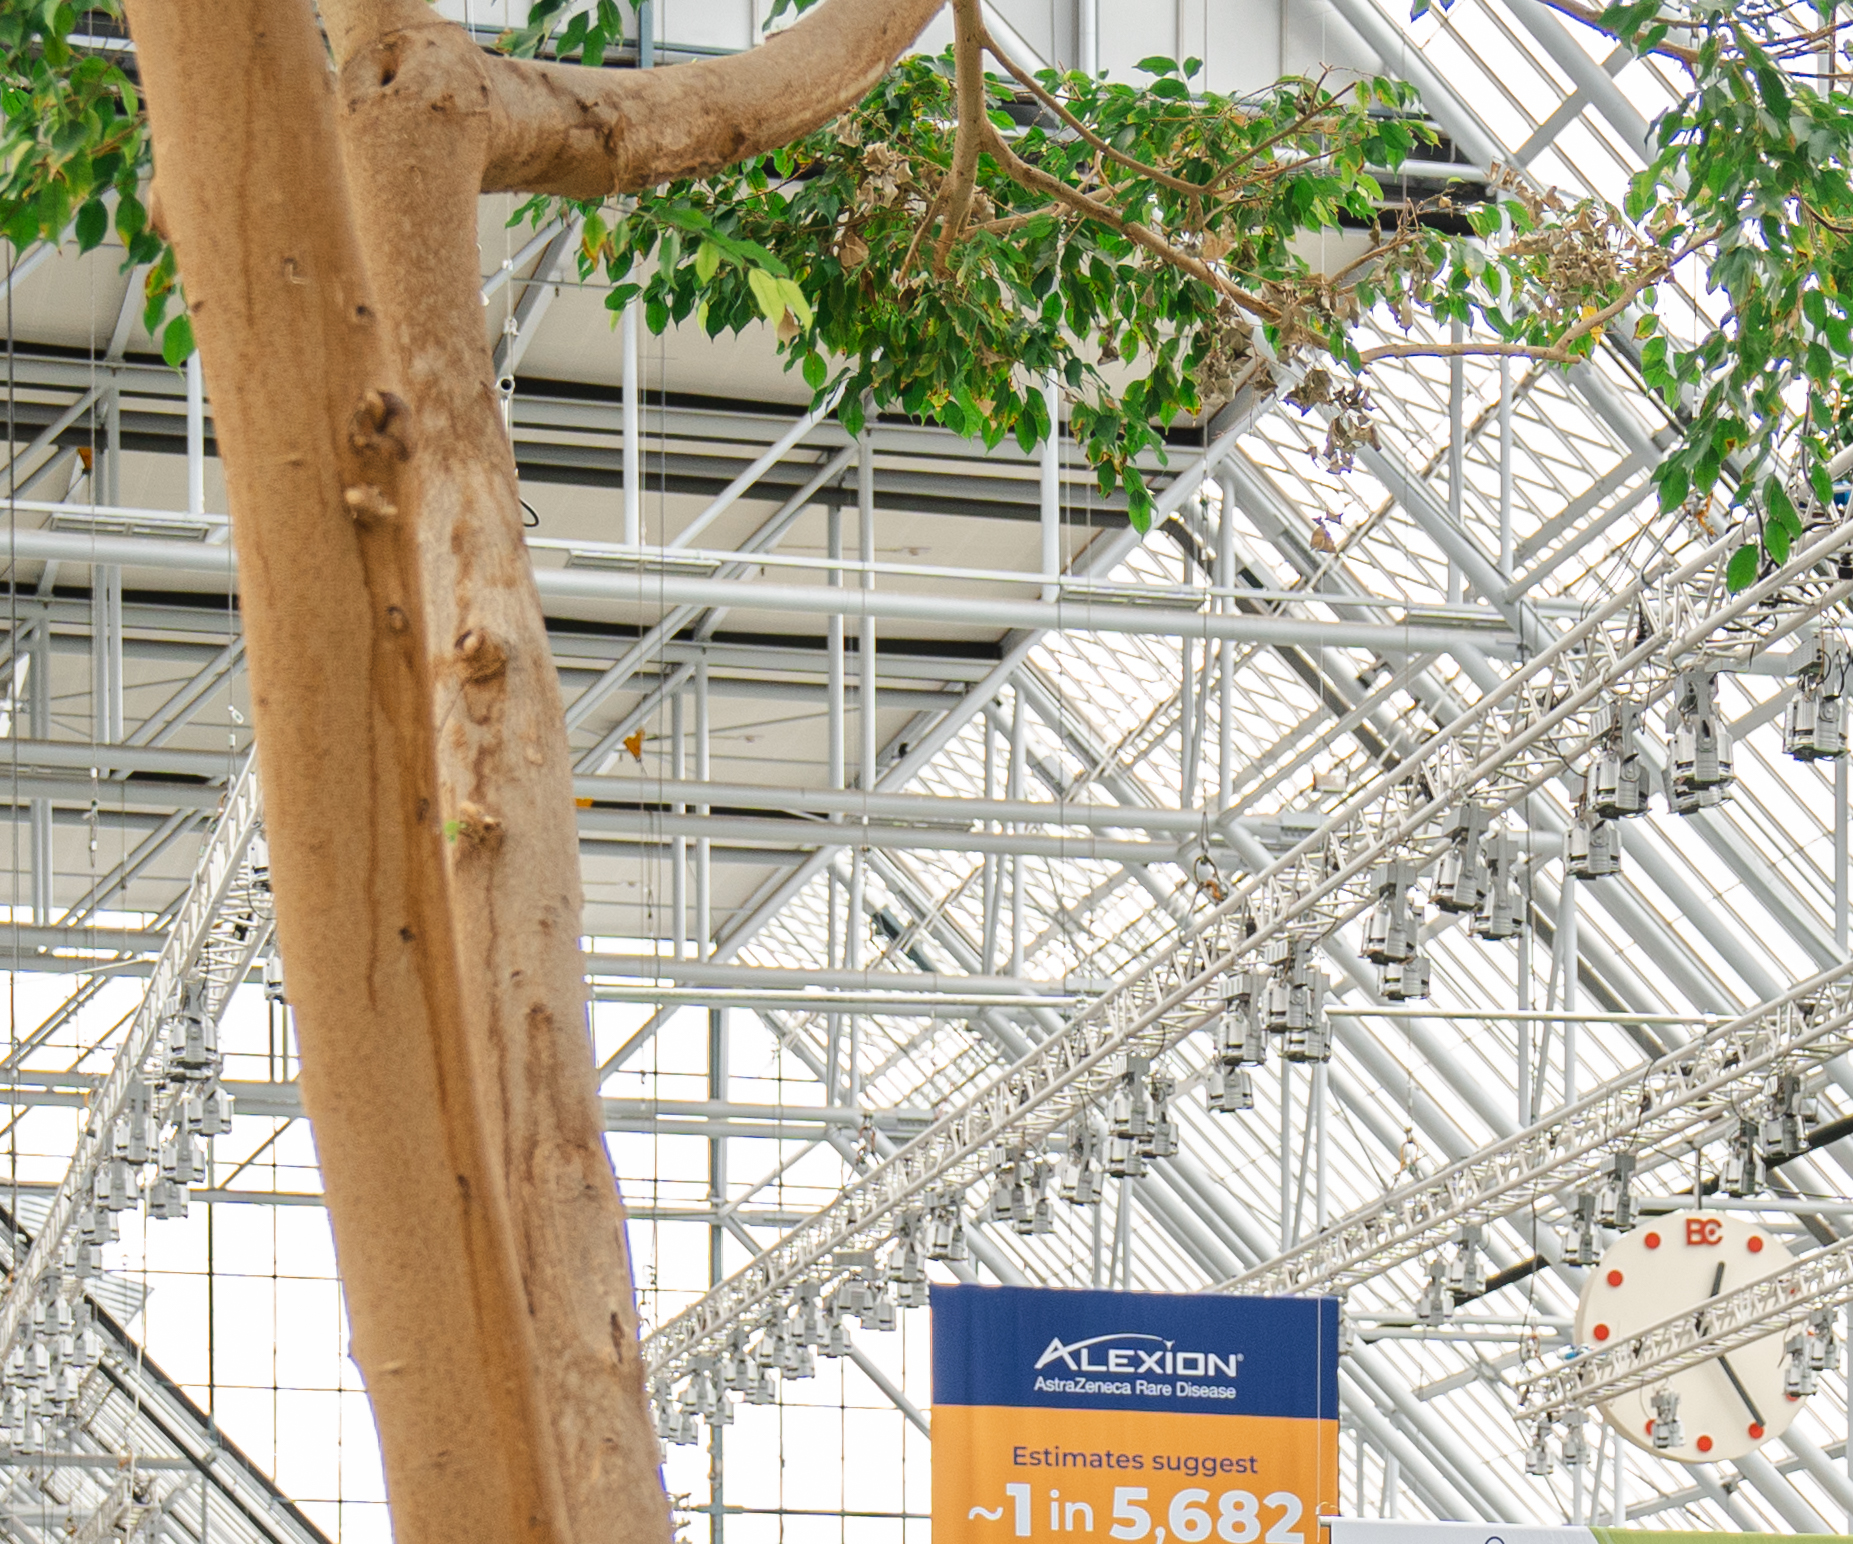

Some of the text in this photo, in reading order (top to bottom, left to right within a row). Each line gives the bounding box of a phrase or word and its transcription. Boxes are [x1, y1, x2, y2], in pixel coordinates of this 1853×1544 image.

[1034, 1376, 1236, 1399] AstraZeneca Rare Disease
[1014, 1446, 1258, 1477] Estimates suggest
[1050, 1489, 1093, 1531] in
